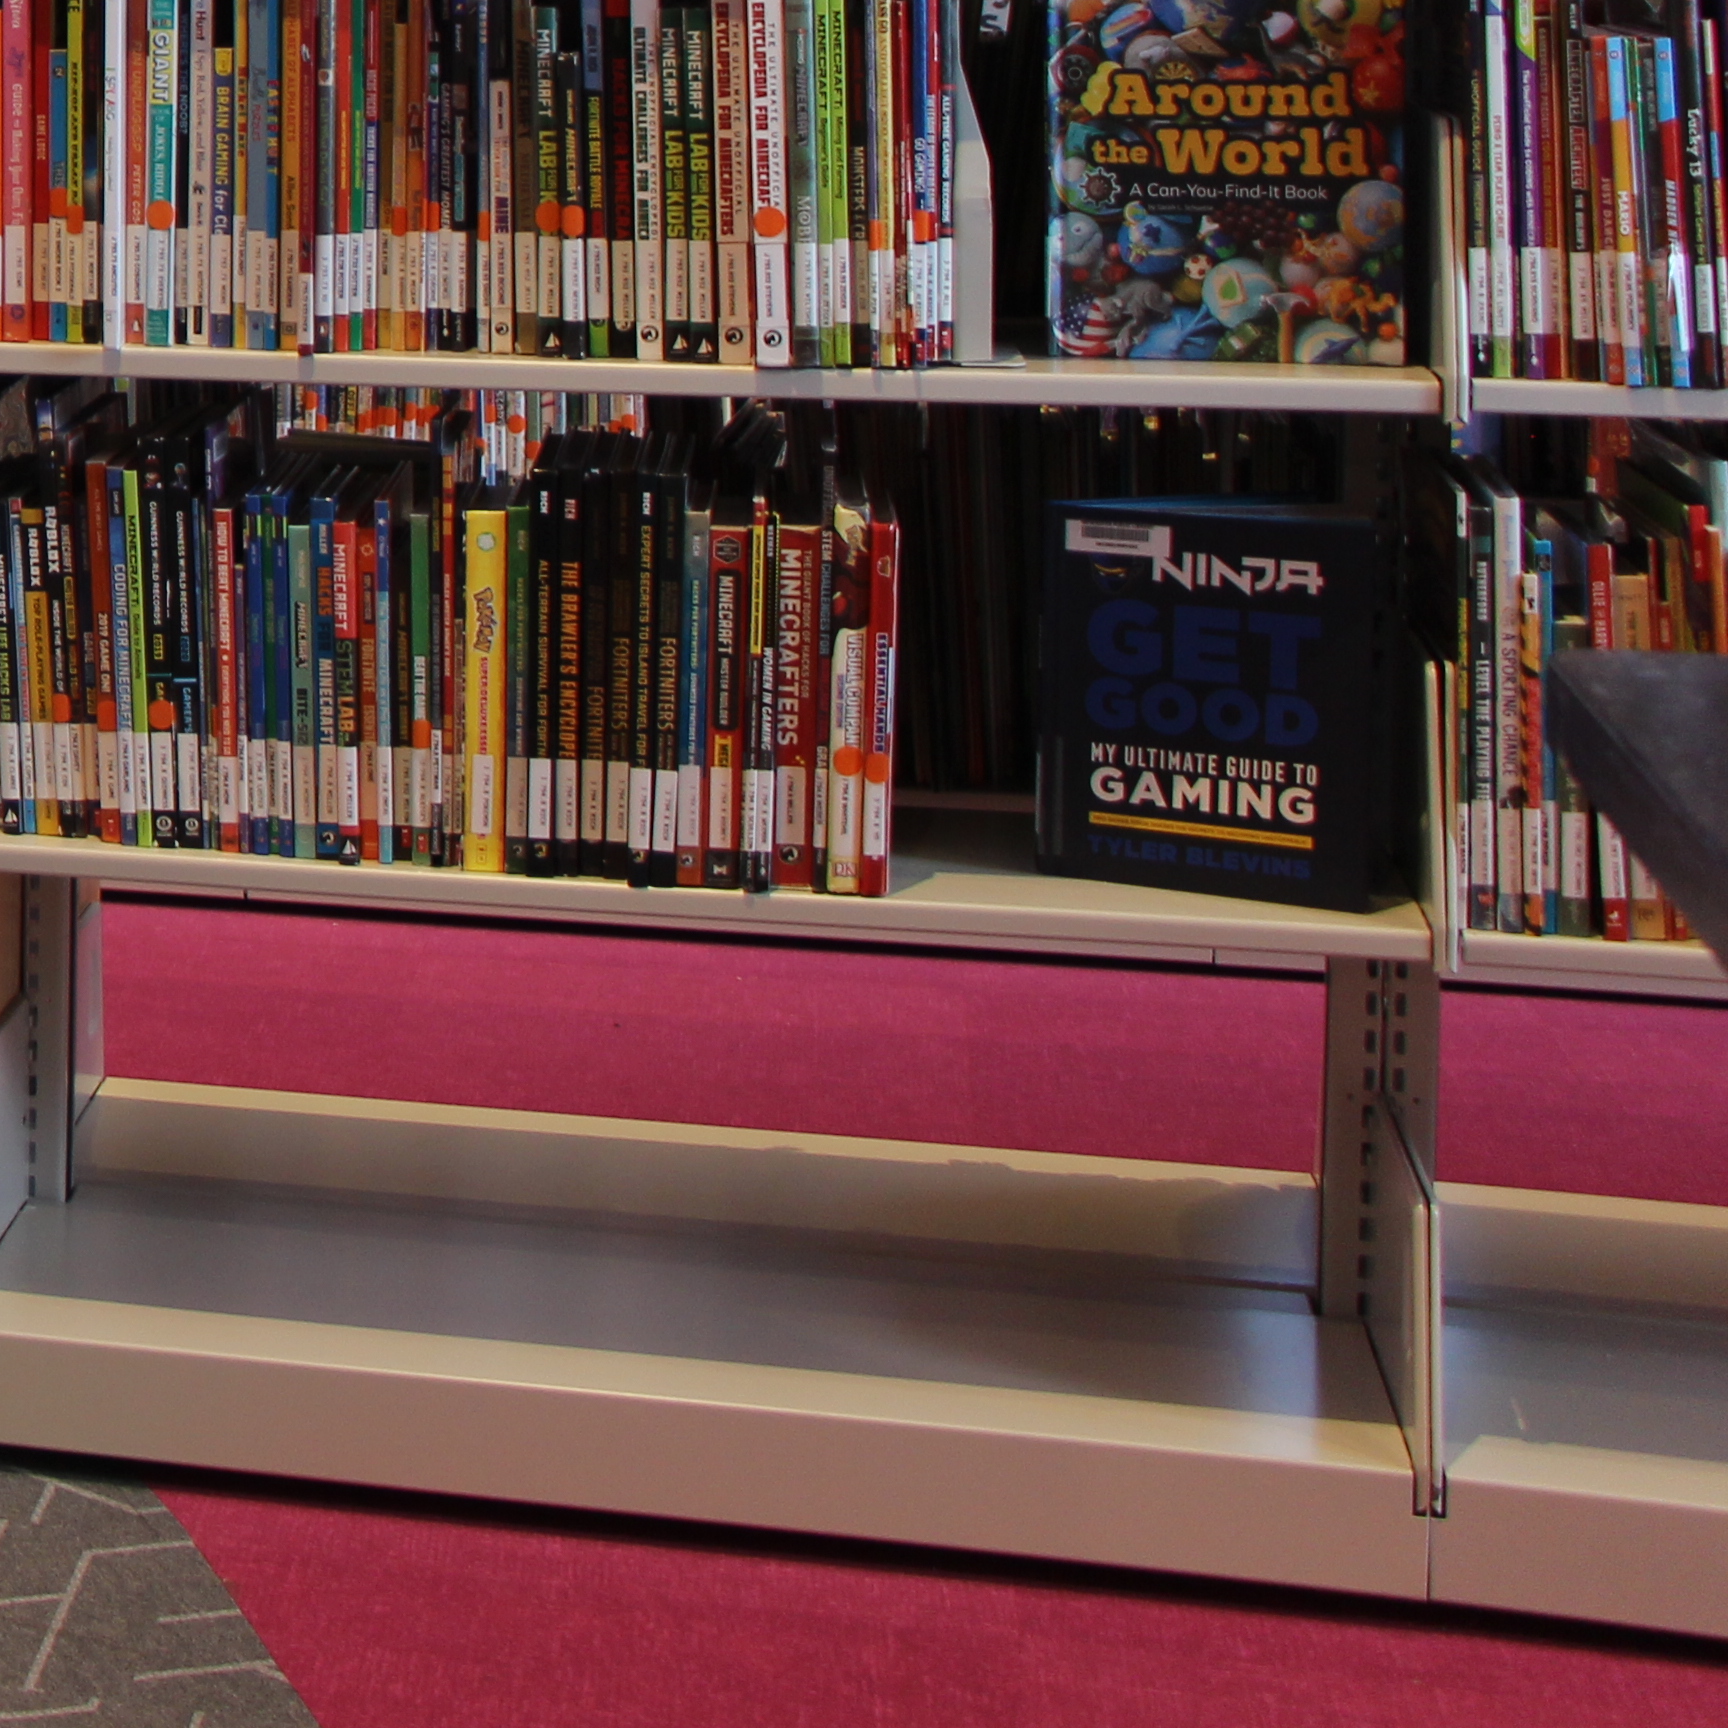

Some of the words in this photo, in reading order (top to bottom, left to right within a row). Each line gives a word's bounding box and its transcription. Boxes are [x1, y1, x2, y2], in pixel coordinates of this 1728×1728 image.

[196, 10, 206, 41] Hunt
[153, 31, 170, 103] GIANT
[633, 27, 648, 85] ULTIMATE
[662, 28, 678, 117] MINECRAFT
[714, 2, 731, 98] ENCYCLOPEDIA
[751, 2, 767, 99] ENCYCLOPEDIA
[817, 15, 827, 110] MINECRAFT
[536, 28, 552, 118] MINECRAFT
[612, 58, 629, 118] HACKS
[687, 30, 704, 120] MINECRAFT
[1108, 72, 1351, 117] Around
[1566, 39, 1583, 122] MINECRAFTER
[216, 86, 231, 130] BRAIN
[589, 96, 601, 138] FORTNITE
[634, 91, 649, 165] CHALLENGES
[717, 105, 732, 130] FOR
[754, 105, 768, 131] FOR
[1470, 78, 1482, 137] UNOFFICIAL
[153, 124, 167, 162] JOKES,
[539, 130, 556, 168] LAB
[612, 122, 629, 156] FOR
[664, 130, 684, 168] LAB
[689, 133, 709, 172] LAB
[1092, 138, 1149, 166] the
[1157, 127, 1370, 177] World
[1685, 108, 1702, 155] Lucky
[216, 133, 230, 185] GAMING
[440, 137, 451, 189] GREATEST
[564, 128, 578, 203] MINECRAFT
[589, 140, 602, 173] BATTLE
[1472, 139, 1483, 172] GUIDE
[1569, 125, 1587, 189] ARCHITECT
[1689, 160, 1702, 178] 13
[216, 189, 229, 211] for
[590, 174, 602, 209] ROYALE
[636, 169, 649, 193] FOR
[718, 138, 734, 236] MINECRAFTERS
[1129, 183, 1143, 196] A
[1147, 182, 1280, 198] Can-You-Find-It
[1284, 184, 1328, 200] Book
[666, 191, 685, 238] KIDS
[691, 194, 710, 240] KIDS
[1617, 190, 1631, 235] MARIO
[149, 501, 159, 546] GUINNESS
[539, 491, 549, 514] RICH
[641, 491, 651, 515] RICH
[45, 506, 60, 573] ROBLOX
[176, 510, 186, 555] GUINNESS
[217, 522, 227, 546] HOW
[218, 547, 228, 561] TO
[640, 525, 651, 569] EXPERT
[820, 529, 833, 561] STEM
[27, 528, 42, 587] ROBLOX
[177, 558, 188, 588] WORLD
[218, 563, 229, 591] BEAT
[560, 562, 579, 587] THE
[1152, 551, 1324, 596] NINJA
[113, 564, 127, 615] CODING
[152, 581, 161, 624] RECORDS
[317, 567, 333, 617] HACKS
[334, 543, 349, 631] MINECRAFT
[538, 559, 549, 633] ALL-TERRAIN
[639, 572, 650, 622] SECRETS
[802, 570, 812, 600] GIANT
[819, 563, 832, 631] CHALLENGES
[1476, 561, 1488, 621] RUTHERFORD
[96, 613, 107, 636] 2019
[115, 620, 129, 648] FOR
[179, 590, 189, 633] RECORDS
[219, 593, 230, 651] MINECRAFT
[559, 593, 579, 674] BRAWLER'S
[638, 625, 649, 640] TO
[717, 575, 734, 655] MINECRAFT
[97, 639, 109, 668] GAME
[317, 623, 333, 652] FOR
[777, 548, 802, 746] MINECRAFTERS
[819, 633, 830, 655] FOR
[844, 635, 863, 683] VISUAL
[1087, 598, 1323, 691] GET
[337, 640, 354, 695] STEM
[362, 638, 375, 693] FORTNITE
[537, 635, 549, 691] SURVIVAL
[611, 637, 629, 730] FORTNITERS
[637, 643, 649, 686] ISLAND
[657, 637, 676, 730] FORTNITERS
[761, 647, 773, 686] WOMEN
[801, 645, 811, 677] HACKS
[1475, 659, 1490, 694] LEVEL
[1501, 647, 1518, 719] SPORTING
[0, 698, 12, 722] LAB
[537, 694, 549, 716] FOR
[636, 688, 648, 731] TRAVEL
[761, 689, 773, 703] IN
[1084, 676, 1319, 747] GOOD
[1475, 698, 1490, 721] THE
[636, 733, 647, 755] FOR
[761, 706, 773, 751] GAMING
[1503, 724, 1519, 777] CHANCE
[1090, 742, 1118, 763] MY
[1124, 745, 1218, 776] ULTIMATE
[1226, 754, 1286, 783] GUIDE
[1292, 762, 1318, 786] TO
[1475, 726, 1491, 778] PLAYING
[1090, 767, 1317, 824] GAMING
[1087, 834, 1178, 865] TYLER
[1186, 846, 1312, 879] BLEVINS
